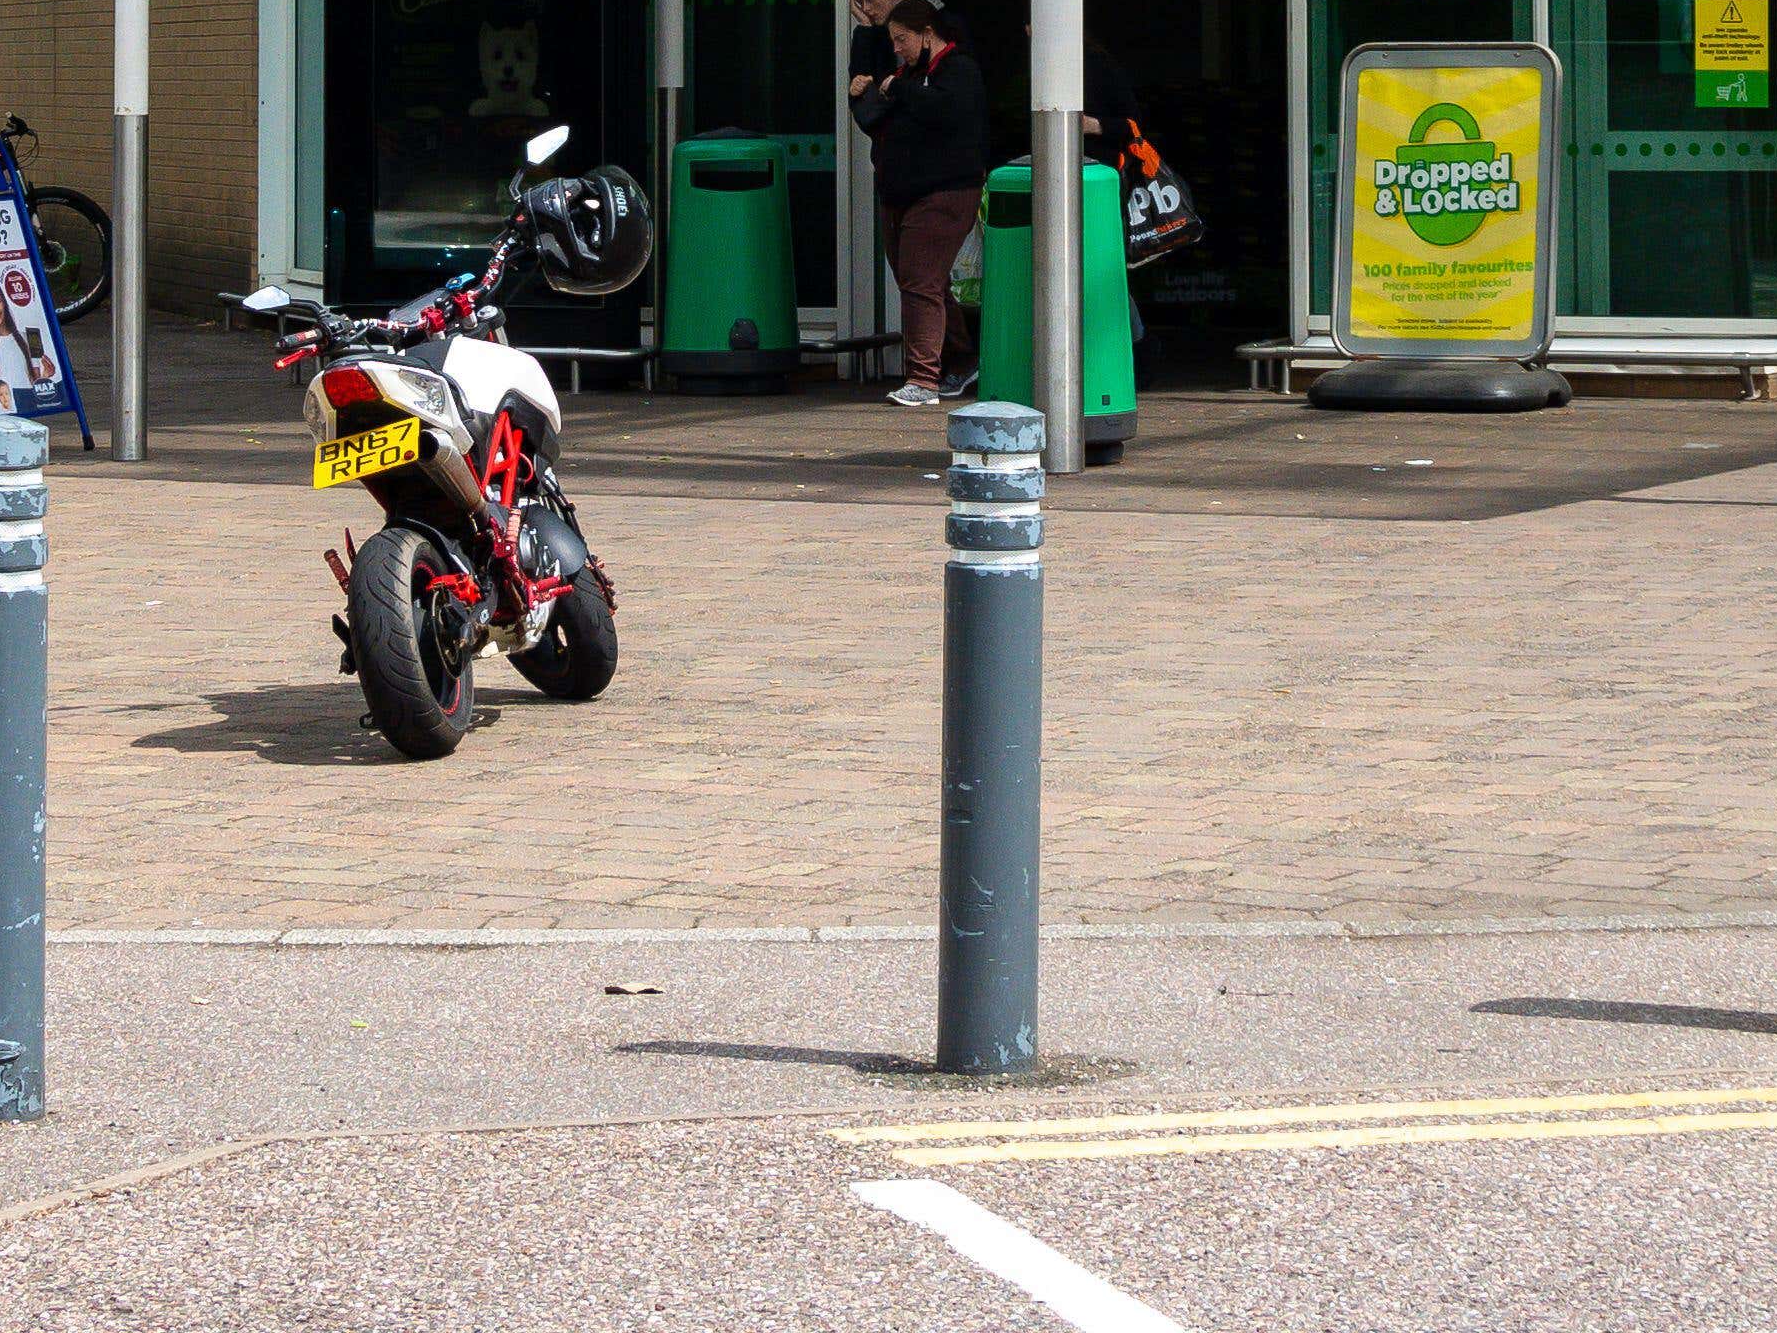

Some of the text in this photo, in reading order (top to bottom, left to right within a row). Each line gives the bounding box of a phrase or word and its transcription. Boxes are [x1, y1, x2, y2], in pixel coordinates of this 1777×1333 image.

[1375, 153, 1510, 189] Dropped
[1375, 183, 1517, 215] & Locked
[1363, 258, 1534, 278] 100 family favourites
[11, 282, 23, 292] 10
[320, 422, 413, 464] BN67
[331, 445, 401, 480] RFO
